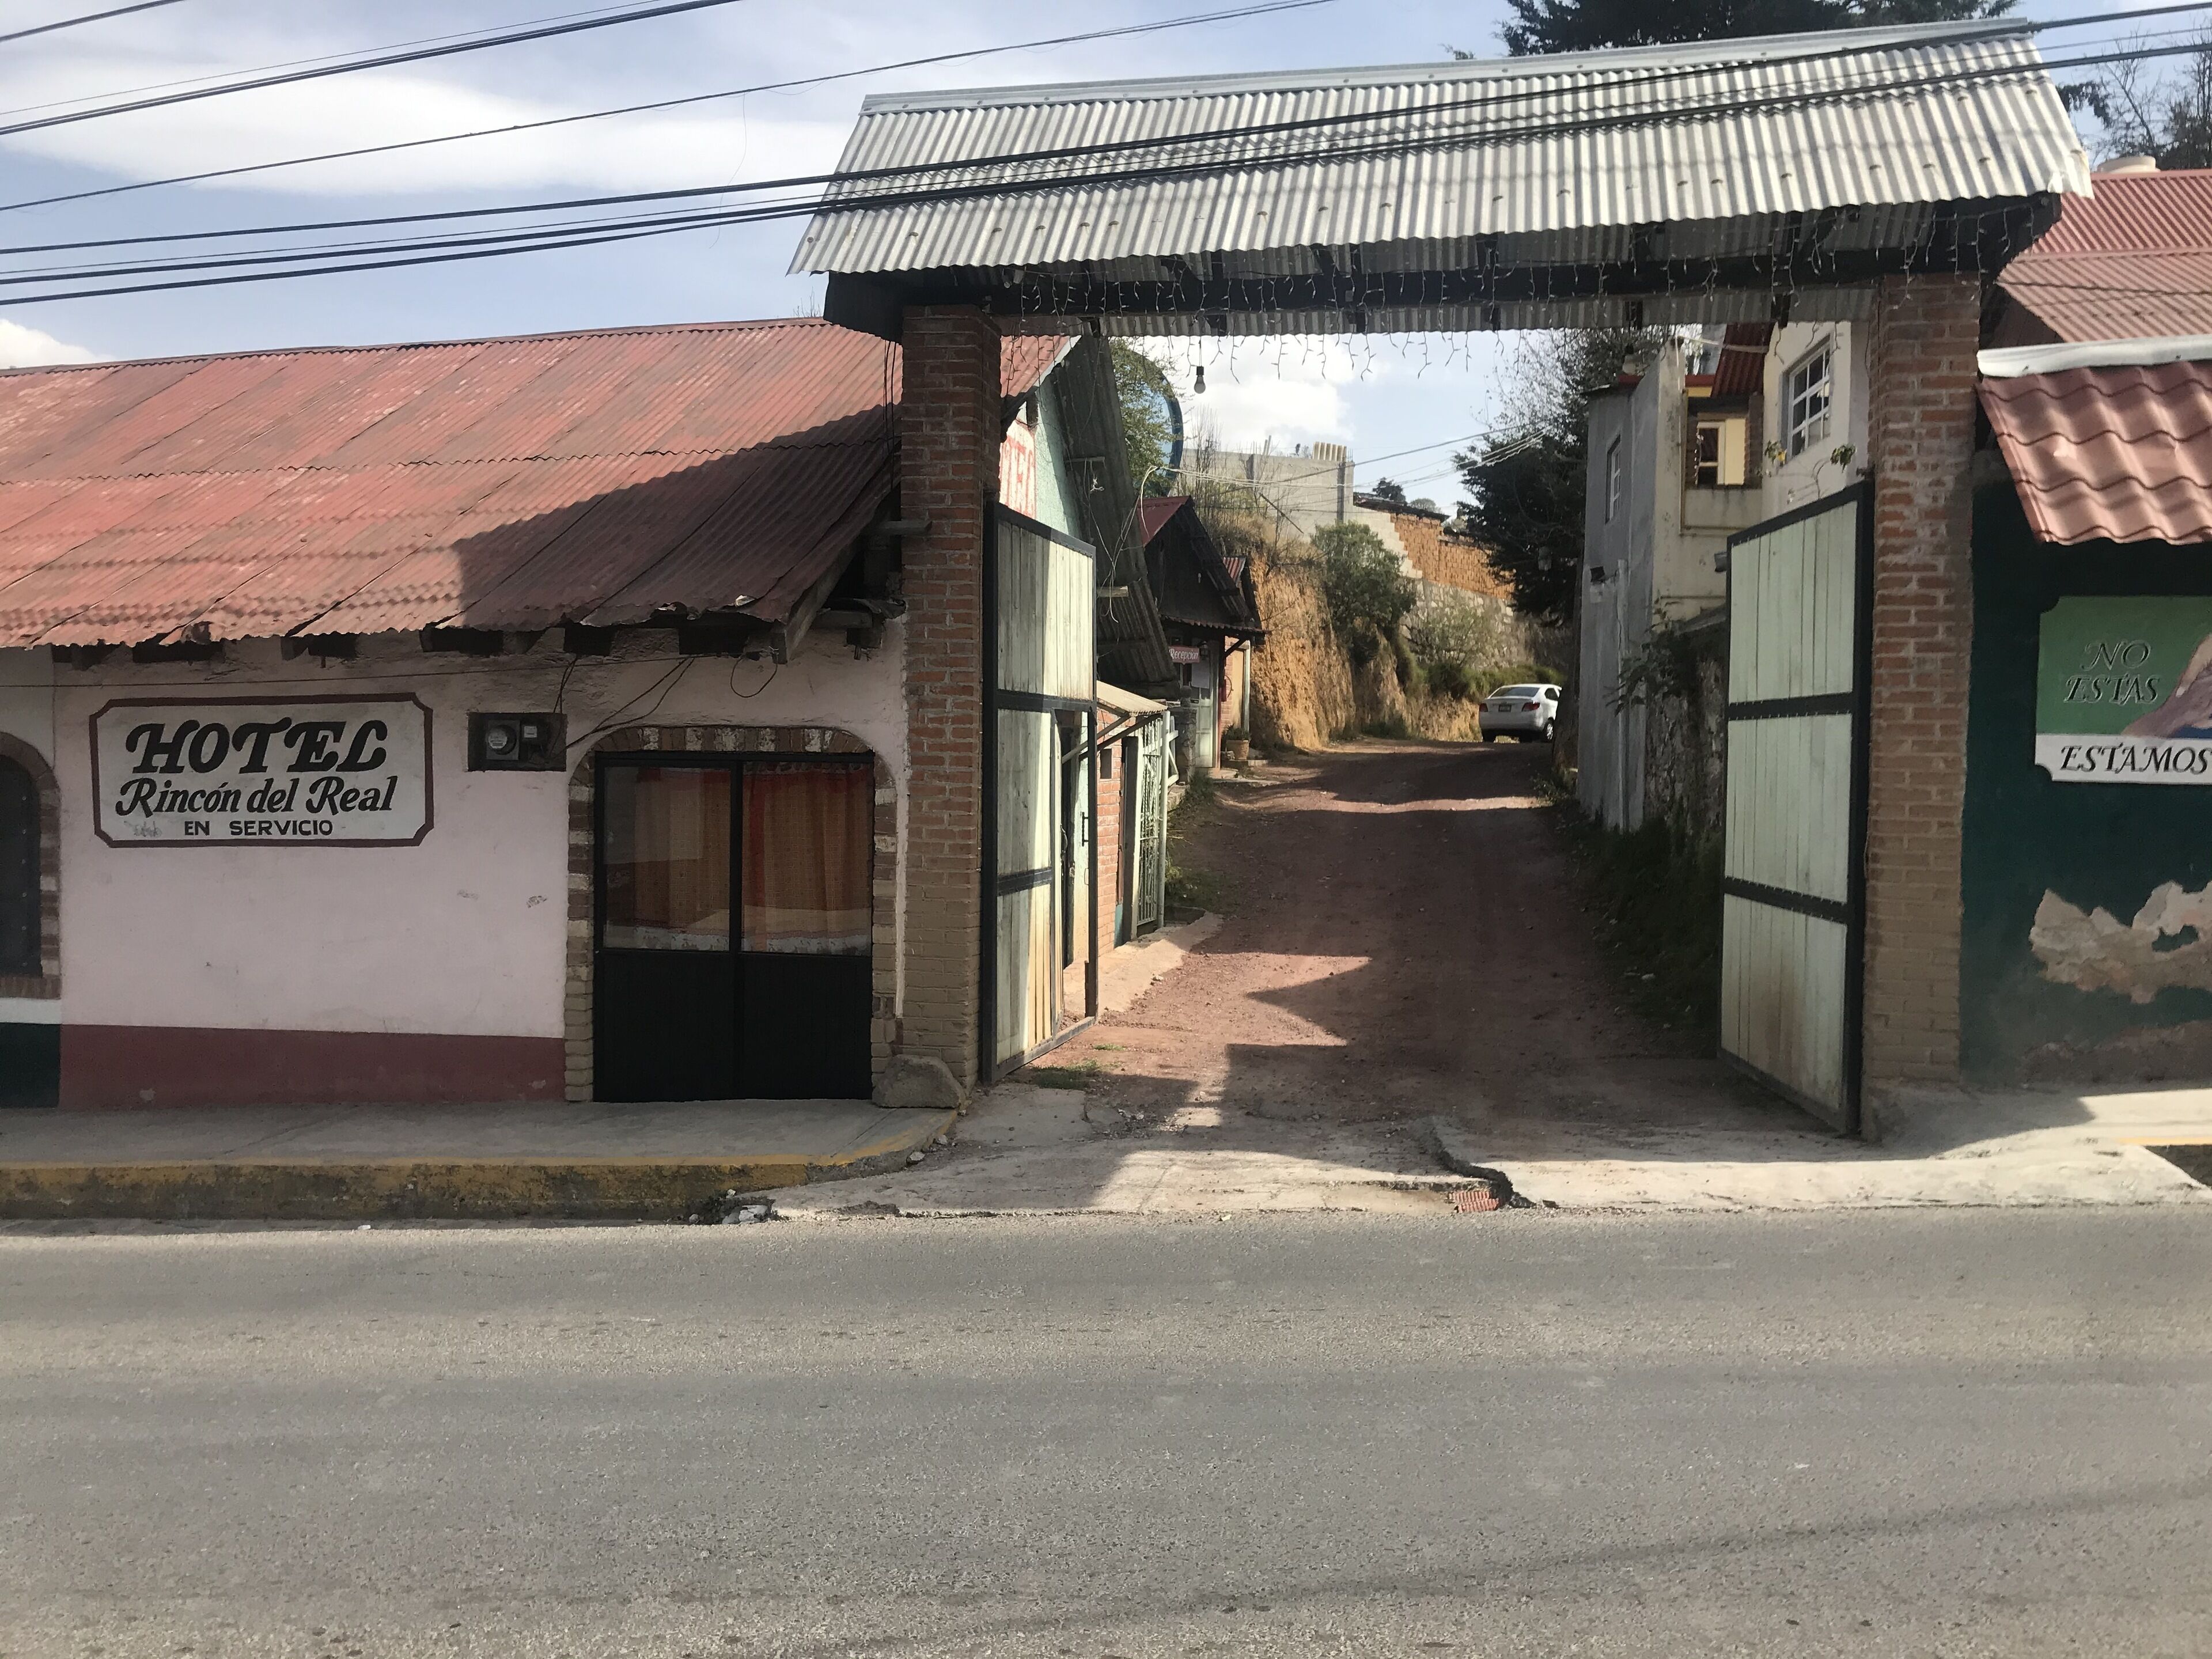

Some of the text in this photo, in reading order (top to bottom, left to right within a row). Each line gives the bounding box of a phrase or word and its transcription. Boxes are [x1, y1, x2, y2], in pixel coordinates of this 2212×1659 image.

[2080, 639, 2152, 671] NO
[2063, 673, 2160, 706] ESTAS
[125, 717, 388, 774] HOTEL
[2061, 742, 2212, 775] ESTAMOS
[115, 775, 399, 818] Rincón del Real
[184, 820, 334, 836] EN SERVICIO
